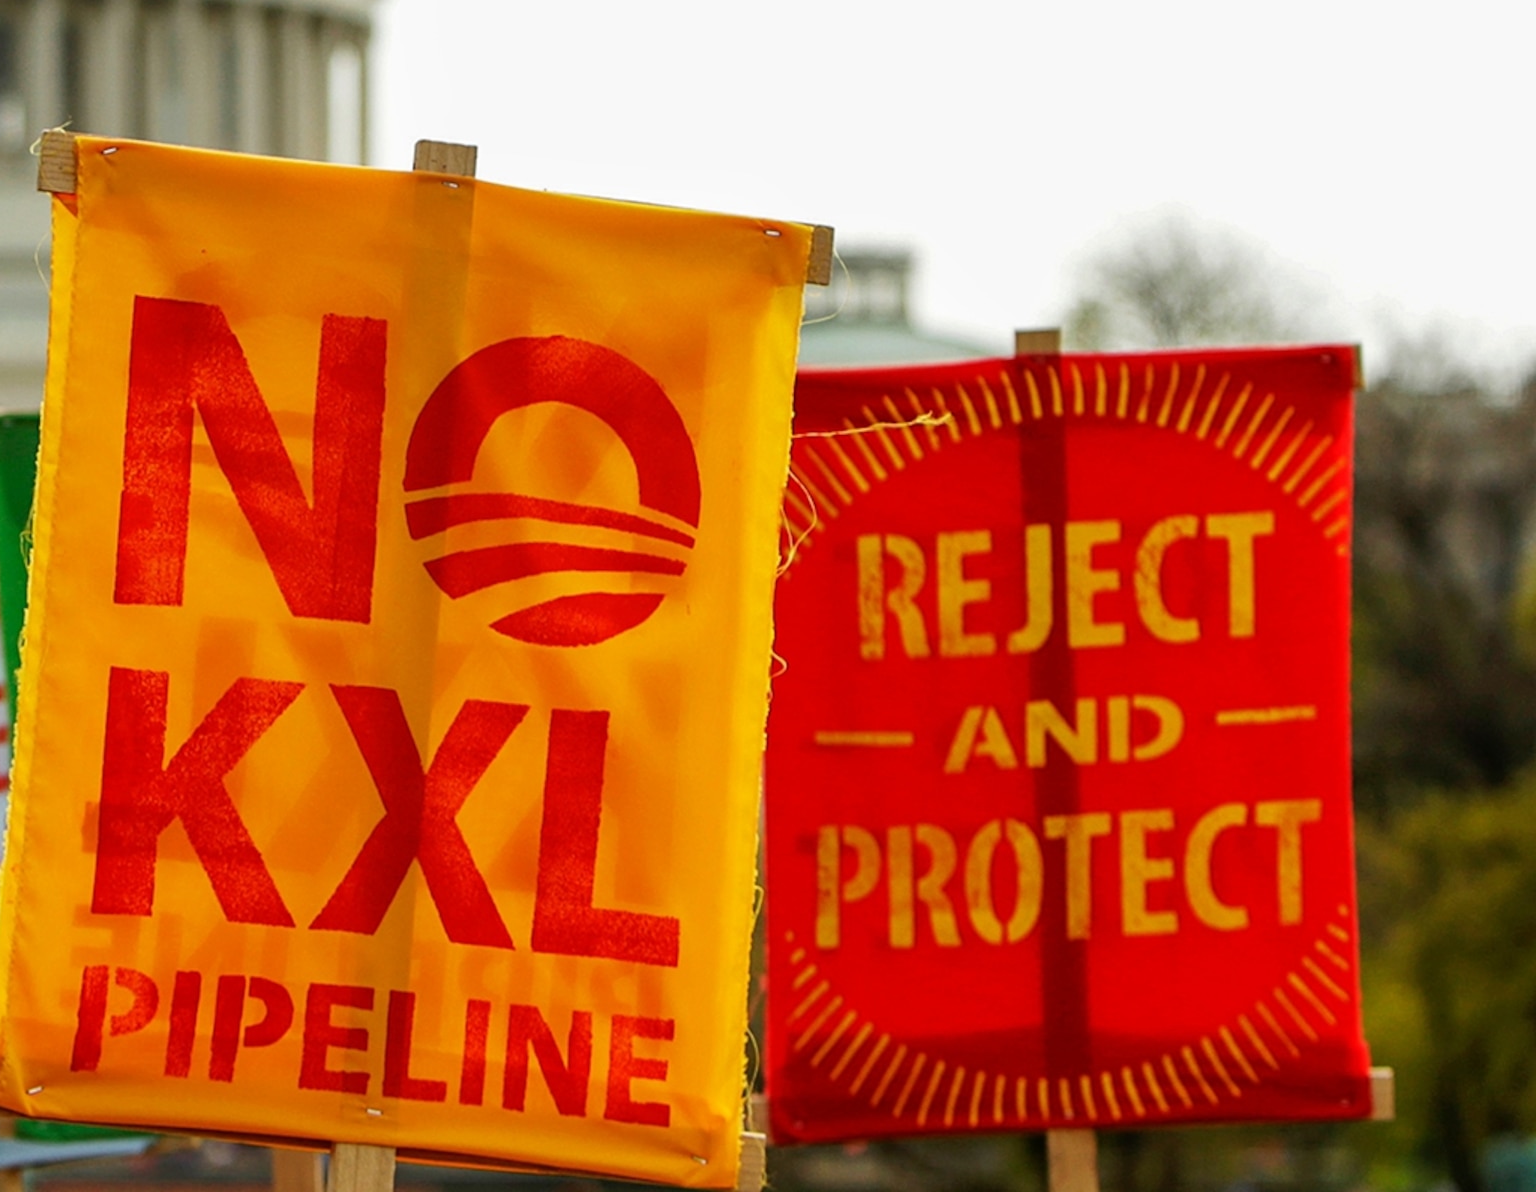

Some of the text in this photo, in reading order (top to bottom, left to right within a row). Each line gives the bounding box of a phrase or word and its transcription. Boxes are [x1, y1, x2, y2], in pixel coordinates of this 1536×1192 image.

[112, 294, 702, 647] NO
[856, 511, 1275, 660] REJECT
[944, 694, 1185, 774] AND
[90, 666, 681, 968] KXL
[815, 798, 1323, 950] PROTECT
[69, 964, 676, 1128] PIPELINE
